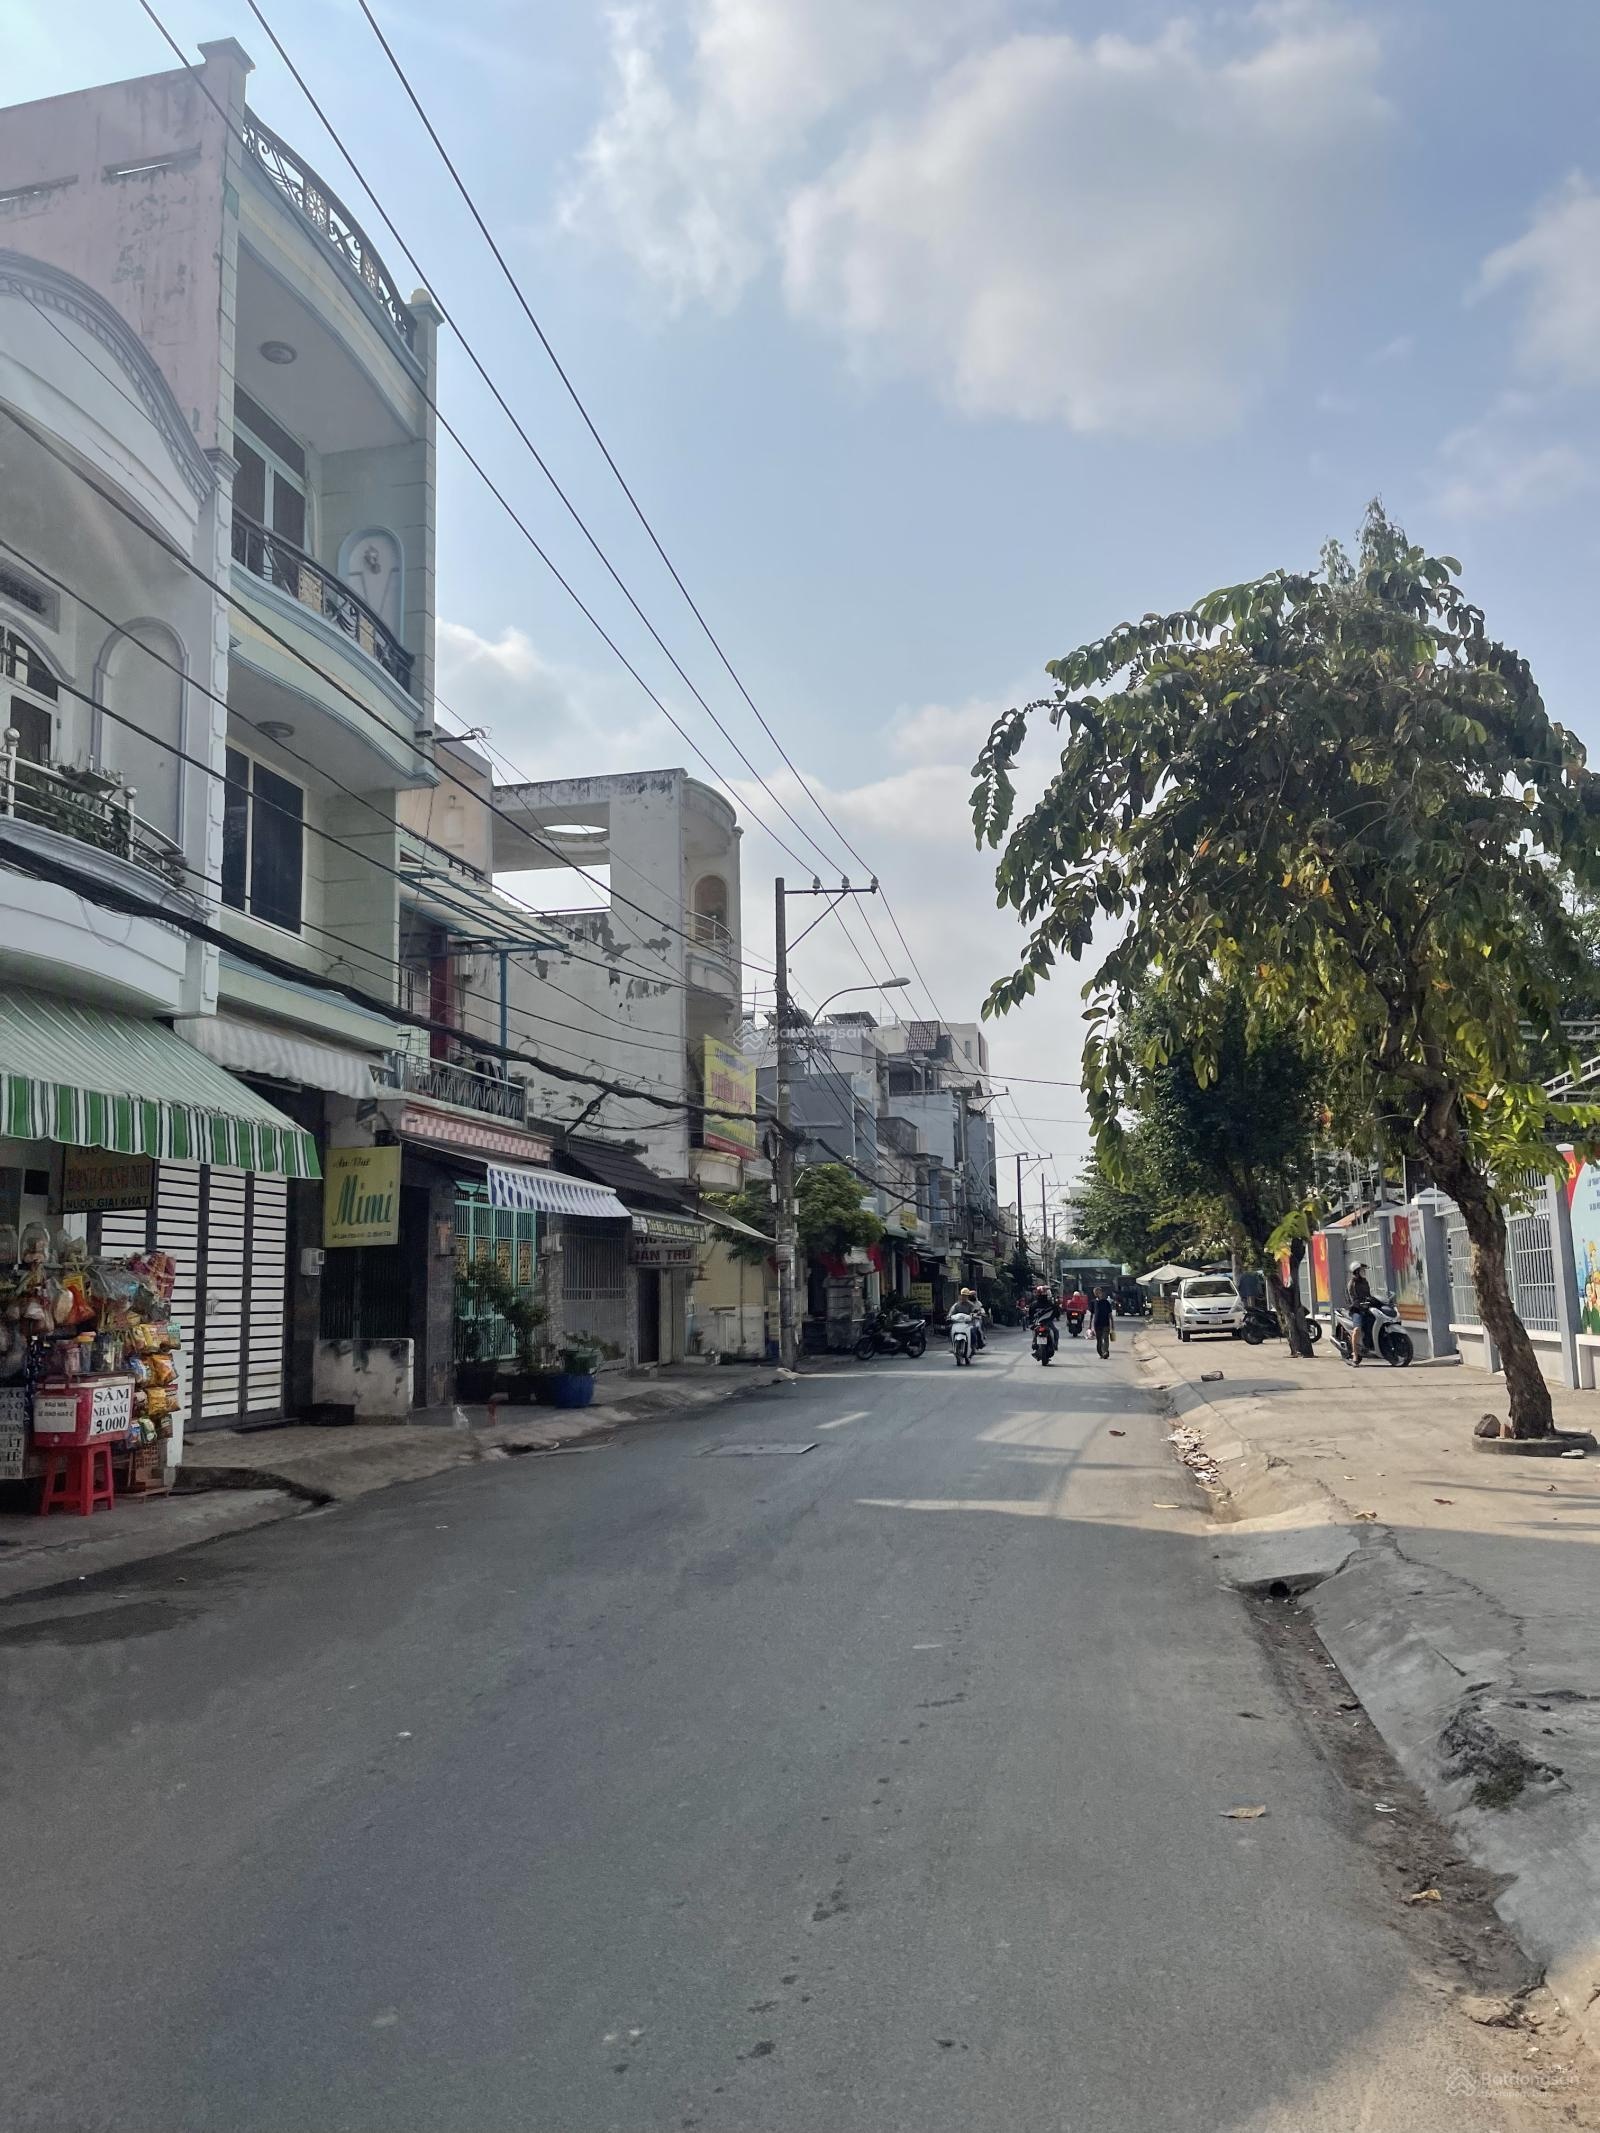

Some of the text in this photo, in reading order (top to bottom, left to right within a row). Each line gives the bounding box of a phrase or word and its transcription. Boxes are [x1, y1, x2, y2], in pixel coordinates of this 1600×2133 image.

[332, 1175, 392, 1225] Mimi
[93, 1387, 129, 1403] SÂM
[96, 1416, 126, 1434] 9.000
